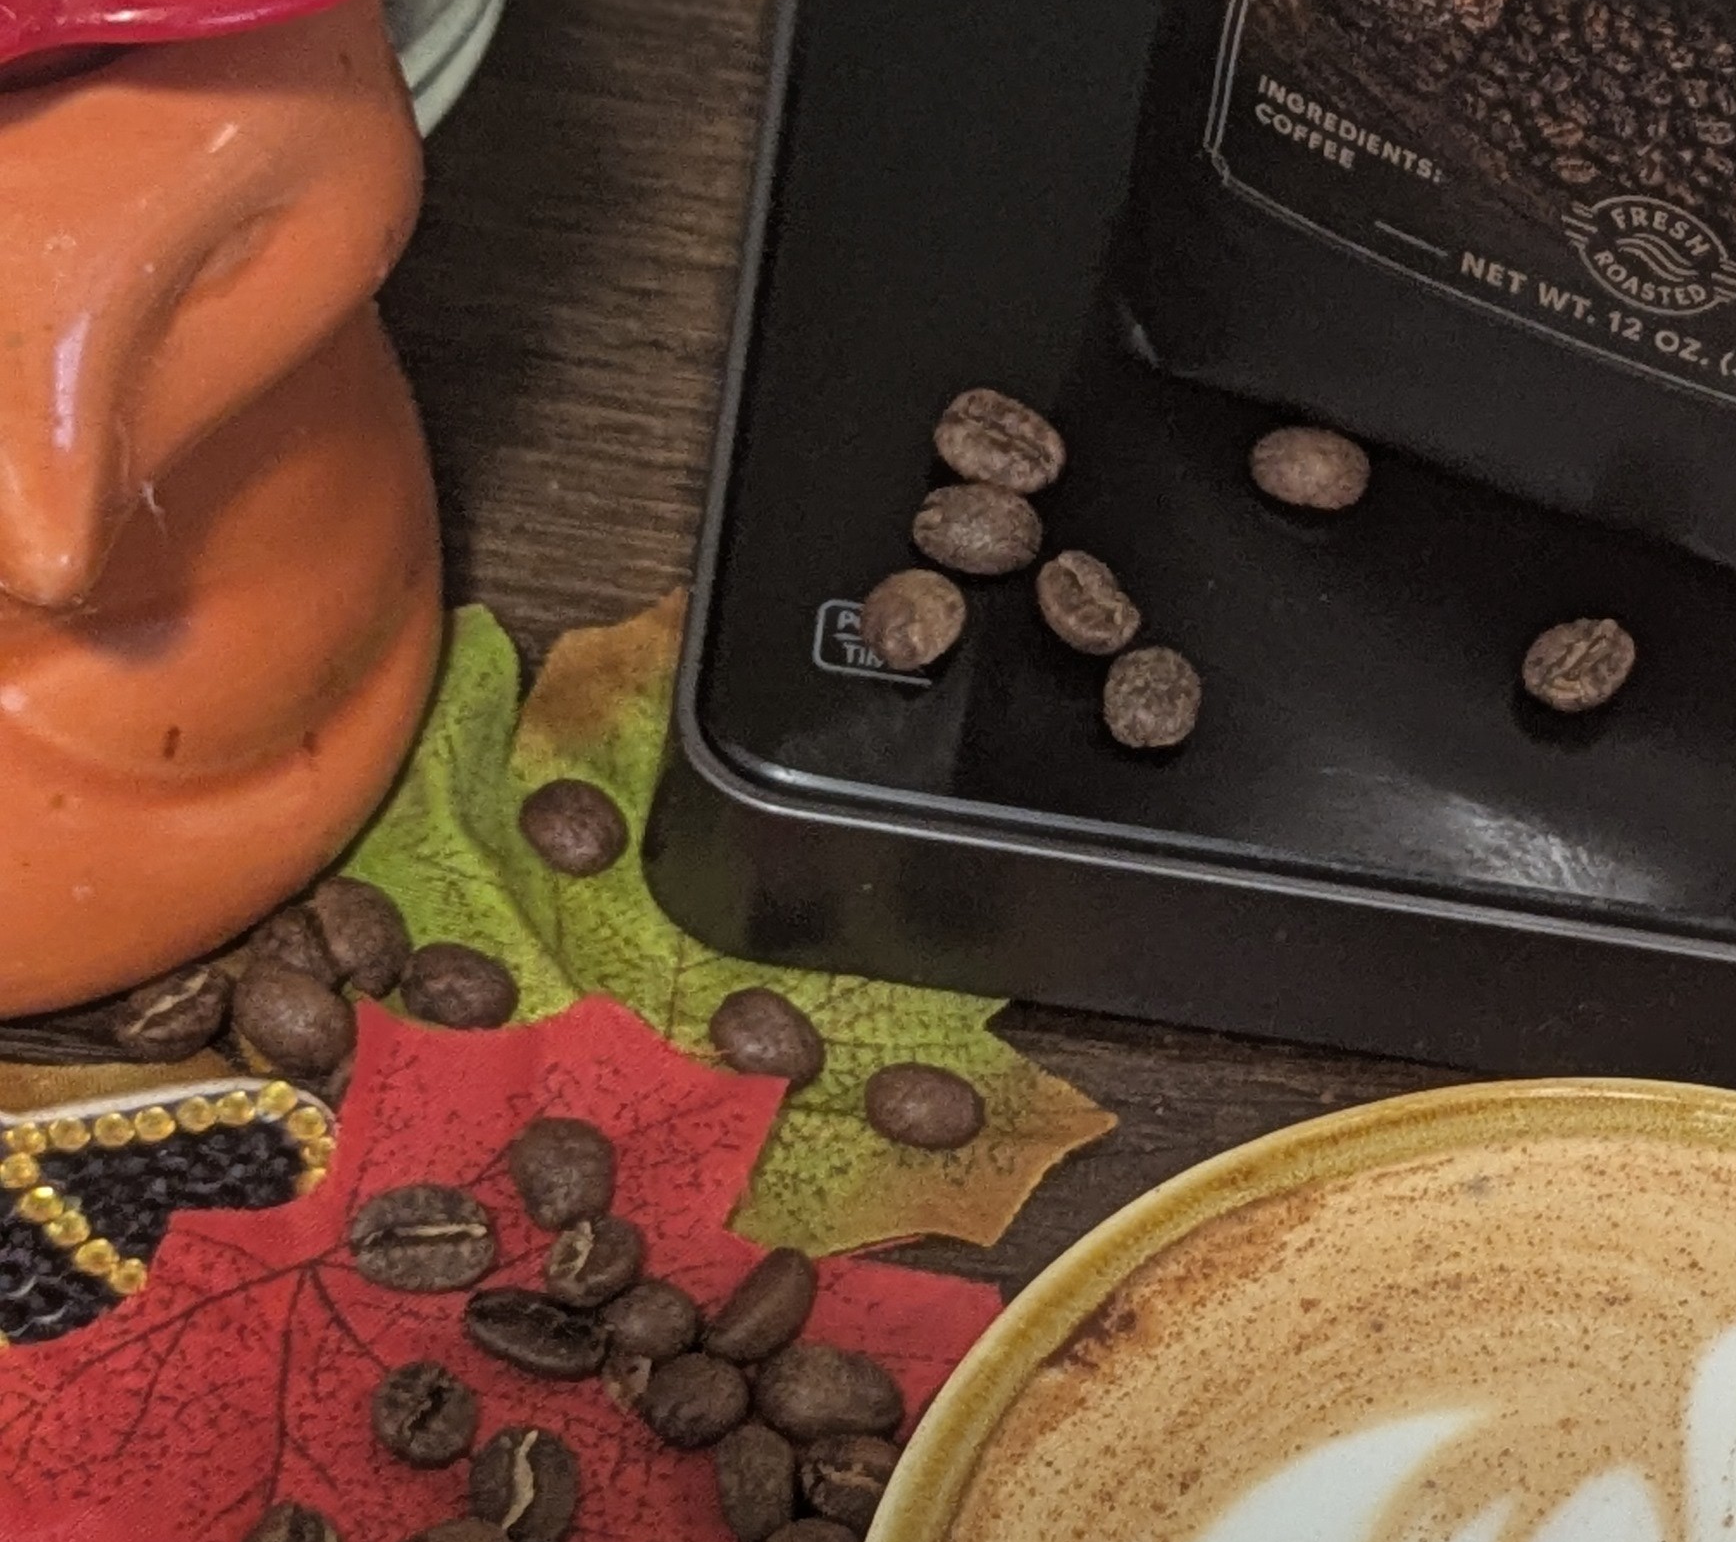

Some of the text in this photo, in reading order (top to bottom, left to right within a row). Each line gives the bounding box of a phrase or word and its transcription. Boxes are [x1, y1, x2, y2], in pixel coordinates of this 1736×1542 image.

[1254, 102, 1356, 169] COFFEE
[1257, 74, 1443, 184] INGREDIENTS:
[1610, 207, 1712, 256] FRESH
[1460, 251, 1529, 295] NET
[1537, 282, 1596, 325] WT.
[1608, 310, 1644, 342] 12
[1654, 330, 1710, 366] OZ.
[1593, 250, 1708, 305] ROASTED
